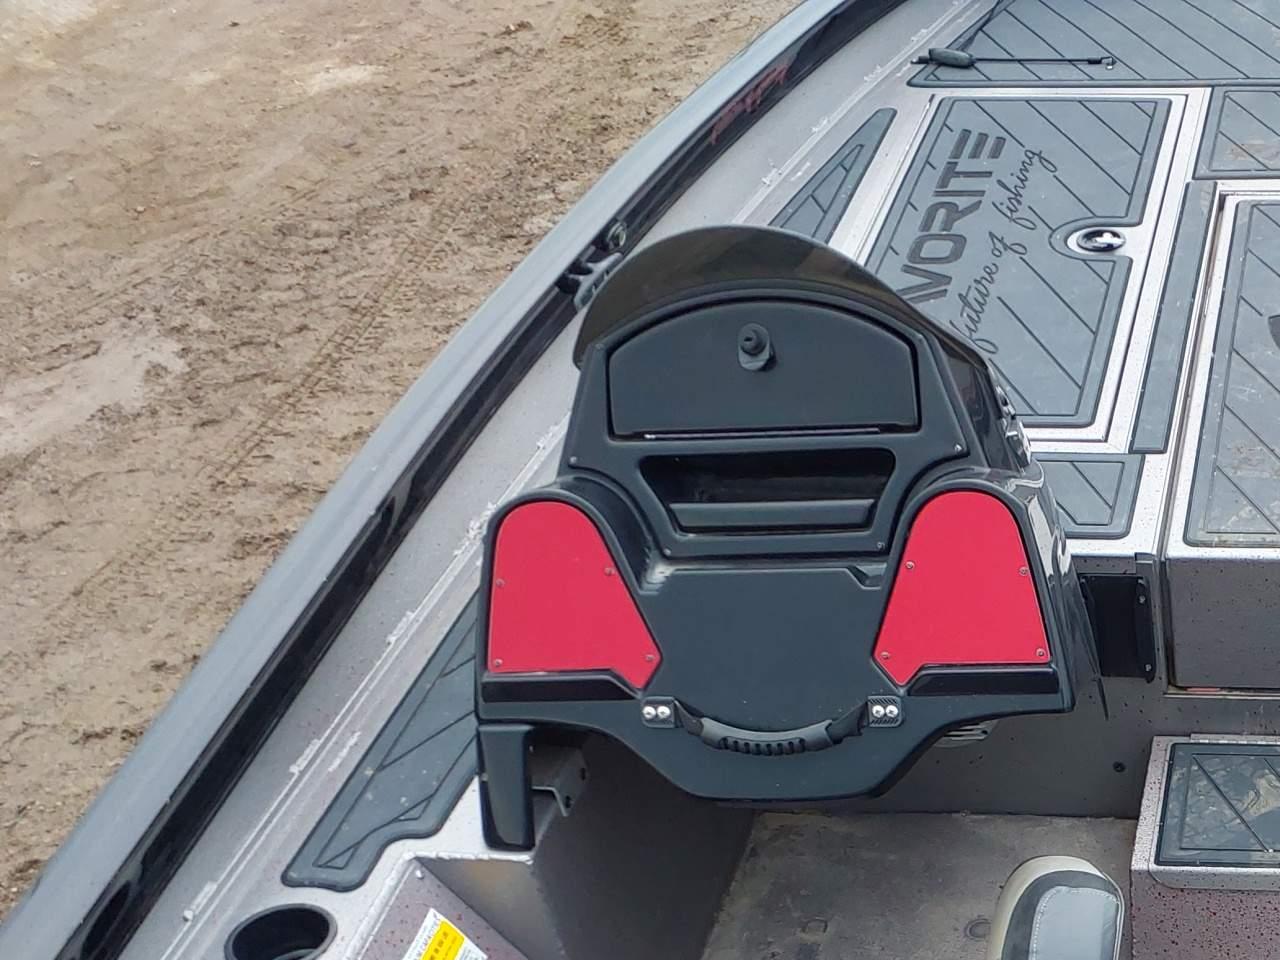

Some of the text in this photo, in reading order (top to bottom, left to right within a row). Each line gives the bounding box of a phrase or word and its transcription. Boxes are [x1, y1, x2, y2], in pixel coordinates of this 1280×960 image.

[949, 148, 1057, 354] future of fishing
